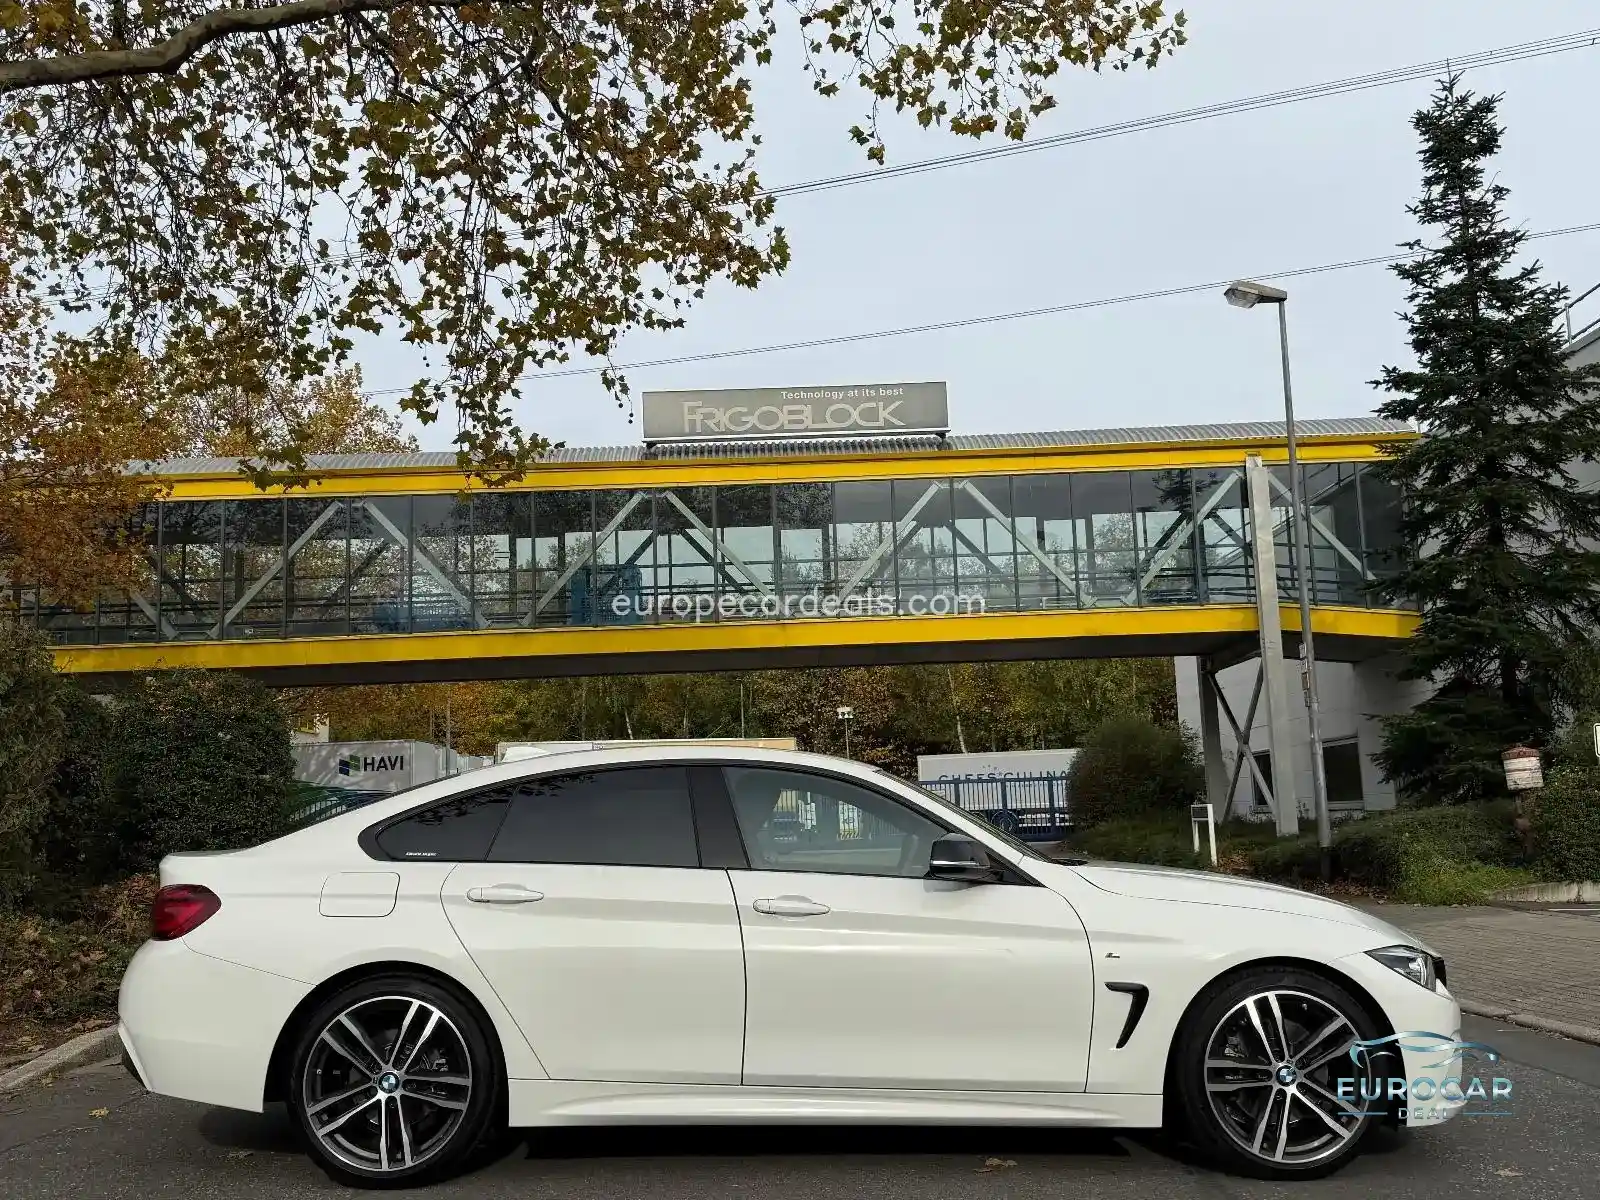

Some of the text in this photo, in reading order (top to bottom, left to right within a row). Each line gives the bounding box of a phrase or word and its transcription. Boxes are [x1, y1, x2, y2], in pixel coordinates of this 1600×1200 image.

[781, 387, 904, 400] Technology at its best
[682, 400, 906, 432] FRIGOBLOCK
[363, 755, 404, 772] HAVI
